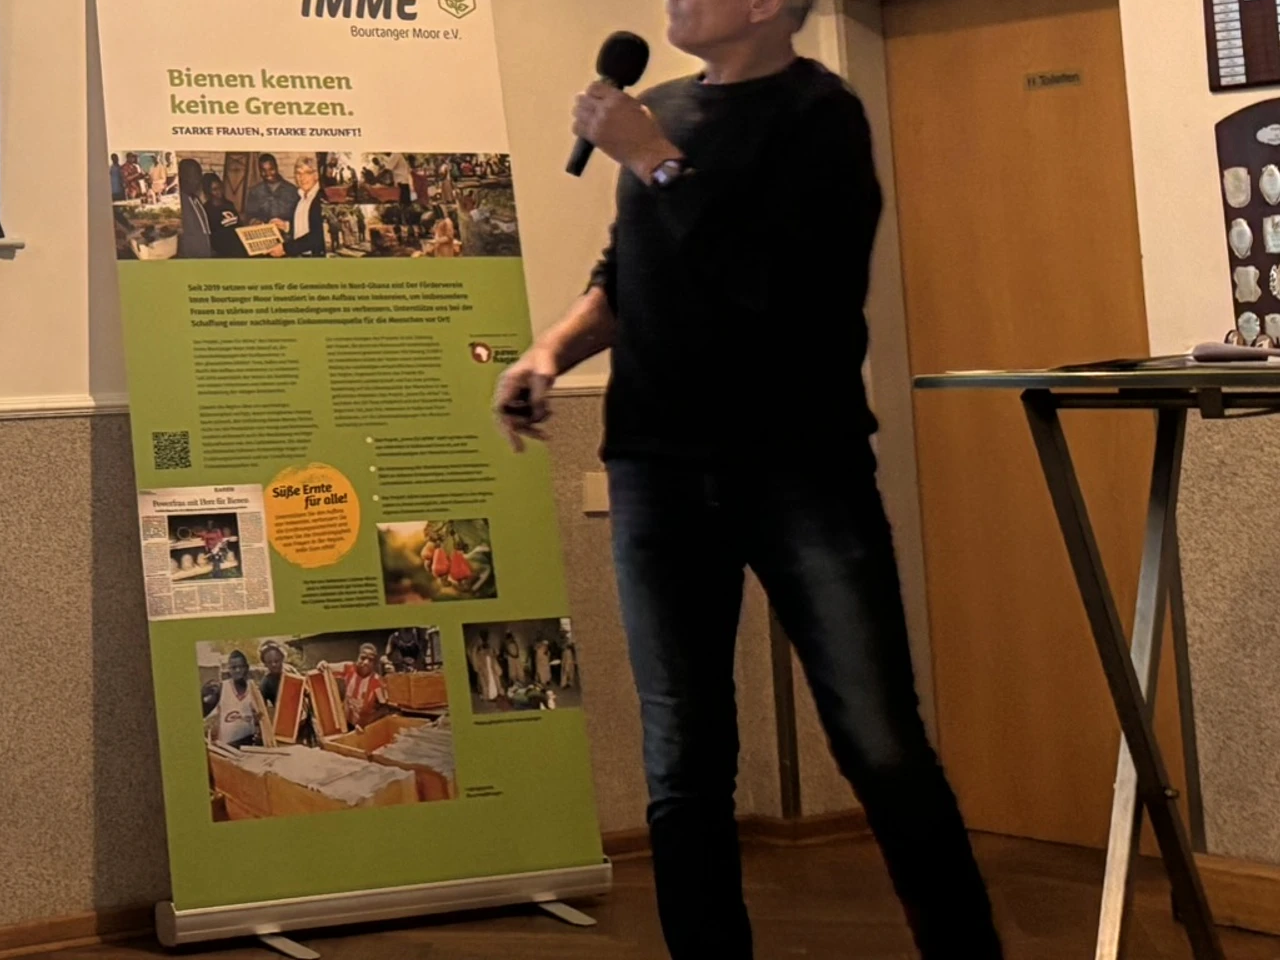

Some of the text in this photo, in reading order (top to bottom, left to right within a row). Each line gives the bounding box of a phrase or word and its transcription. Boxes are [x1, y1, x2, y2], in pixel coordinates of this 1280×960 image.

[350, 25, 462, 41] Bourtanger Moor e.V.
[167, 67, 353, 90] Bienen kennen
[170, 94, 354, 116] keine Grenzen.
[172, 126, 362, 137] STARKE FRAUEN, STARKE ZUKUNFT!
[272, 483, 332, 499] Süße Ernte
[304, 493, 348, 510] für alle!
